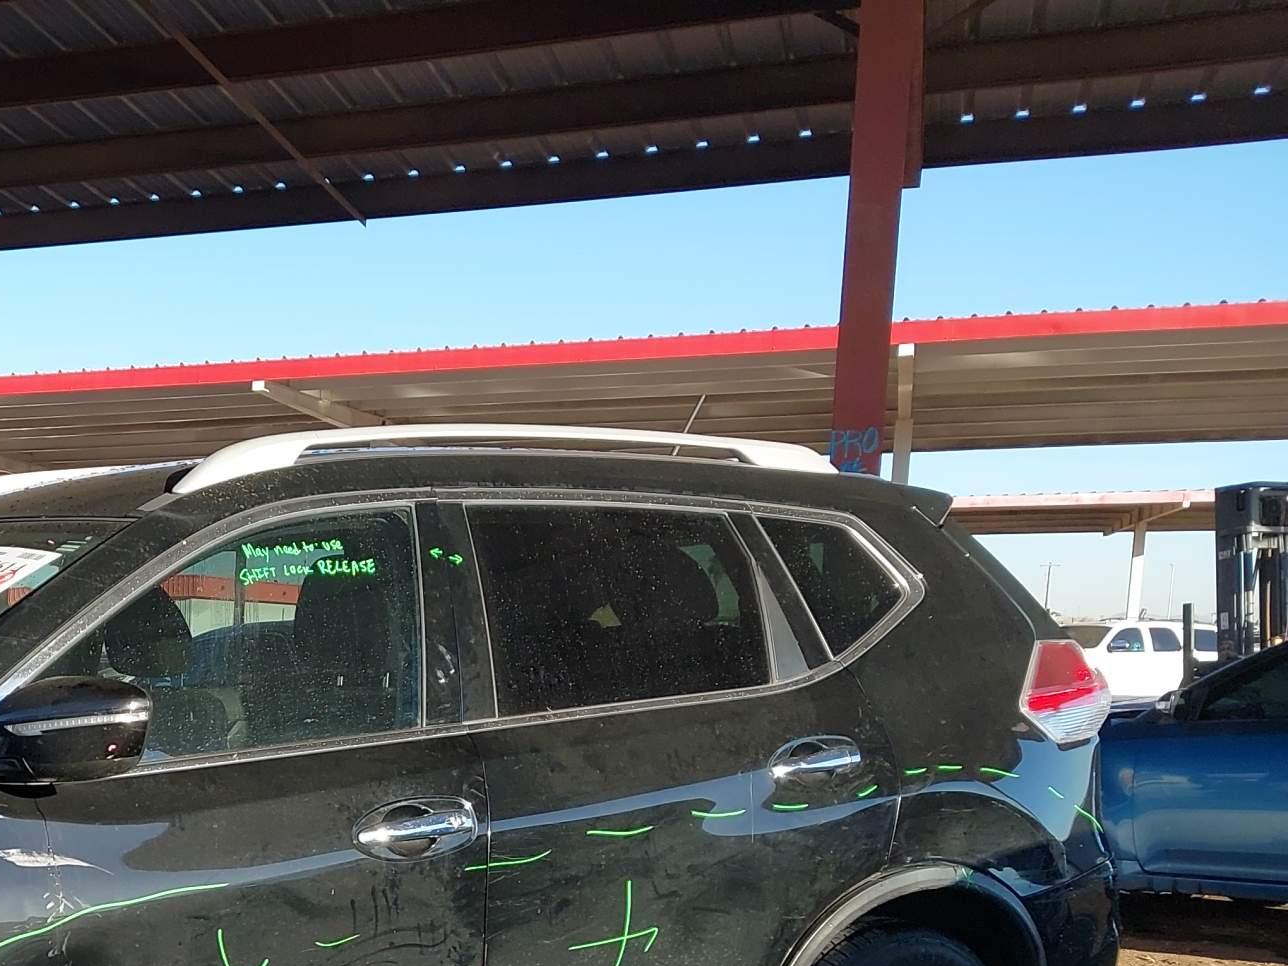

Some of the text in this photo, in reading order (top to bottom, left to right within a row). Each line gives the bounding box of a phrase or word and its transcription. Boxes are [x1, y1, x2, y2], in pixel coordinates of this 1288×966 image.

[241, 543, 270, 563] May
[273, 543, 300, 556] need
[321, 538, 344, 551] use
[239, 563, 277, 586] SHIFT
[316, 557, 376, 577] RELEASE
